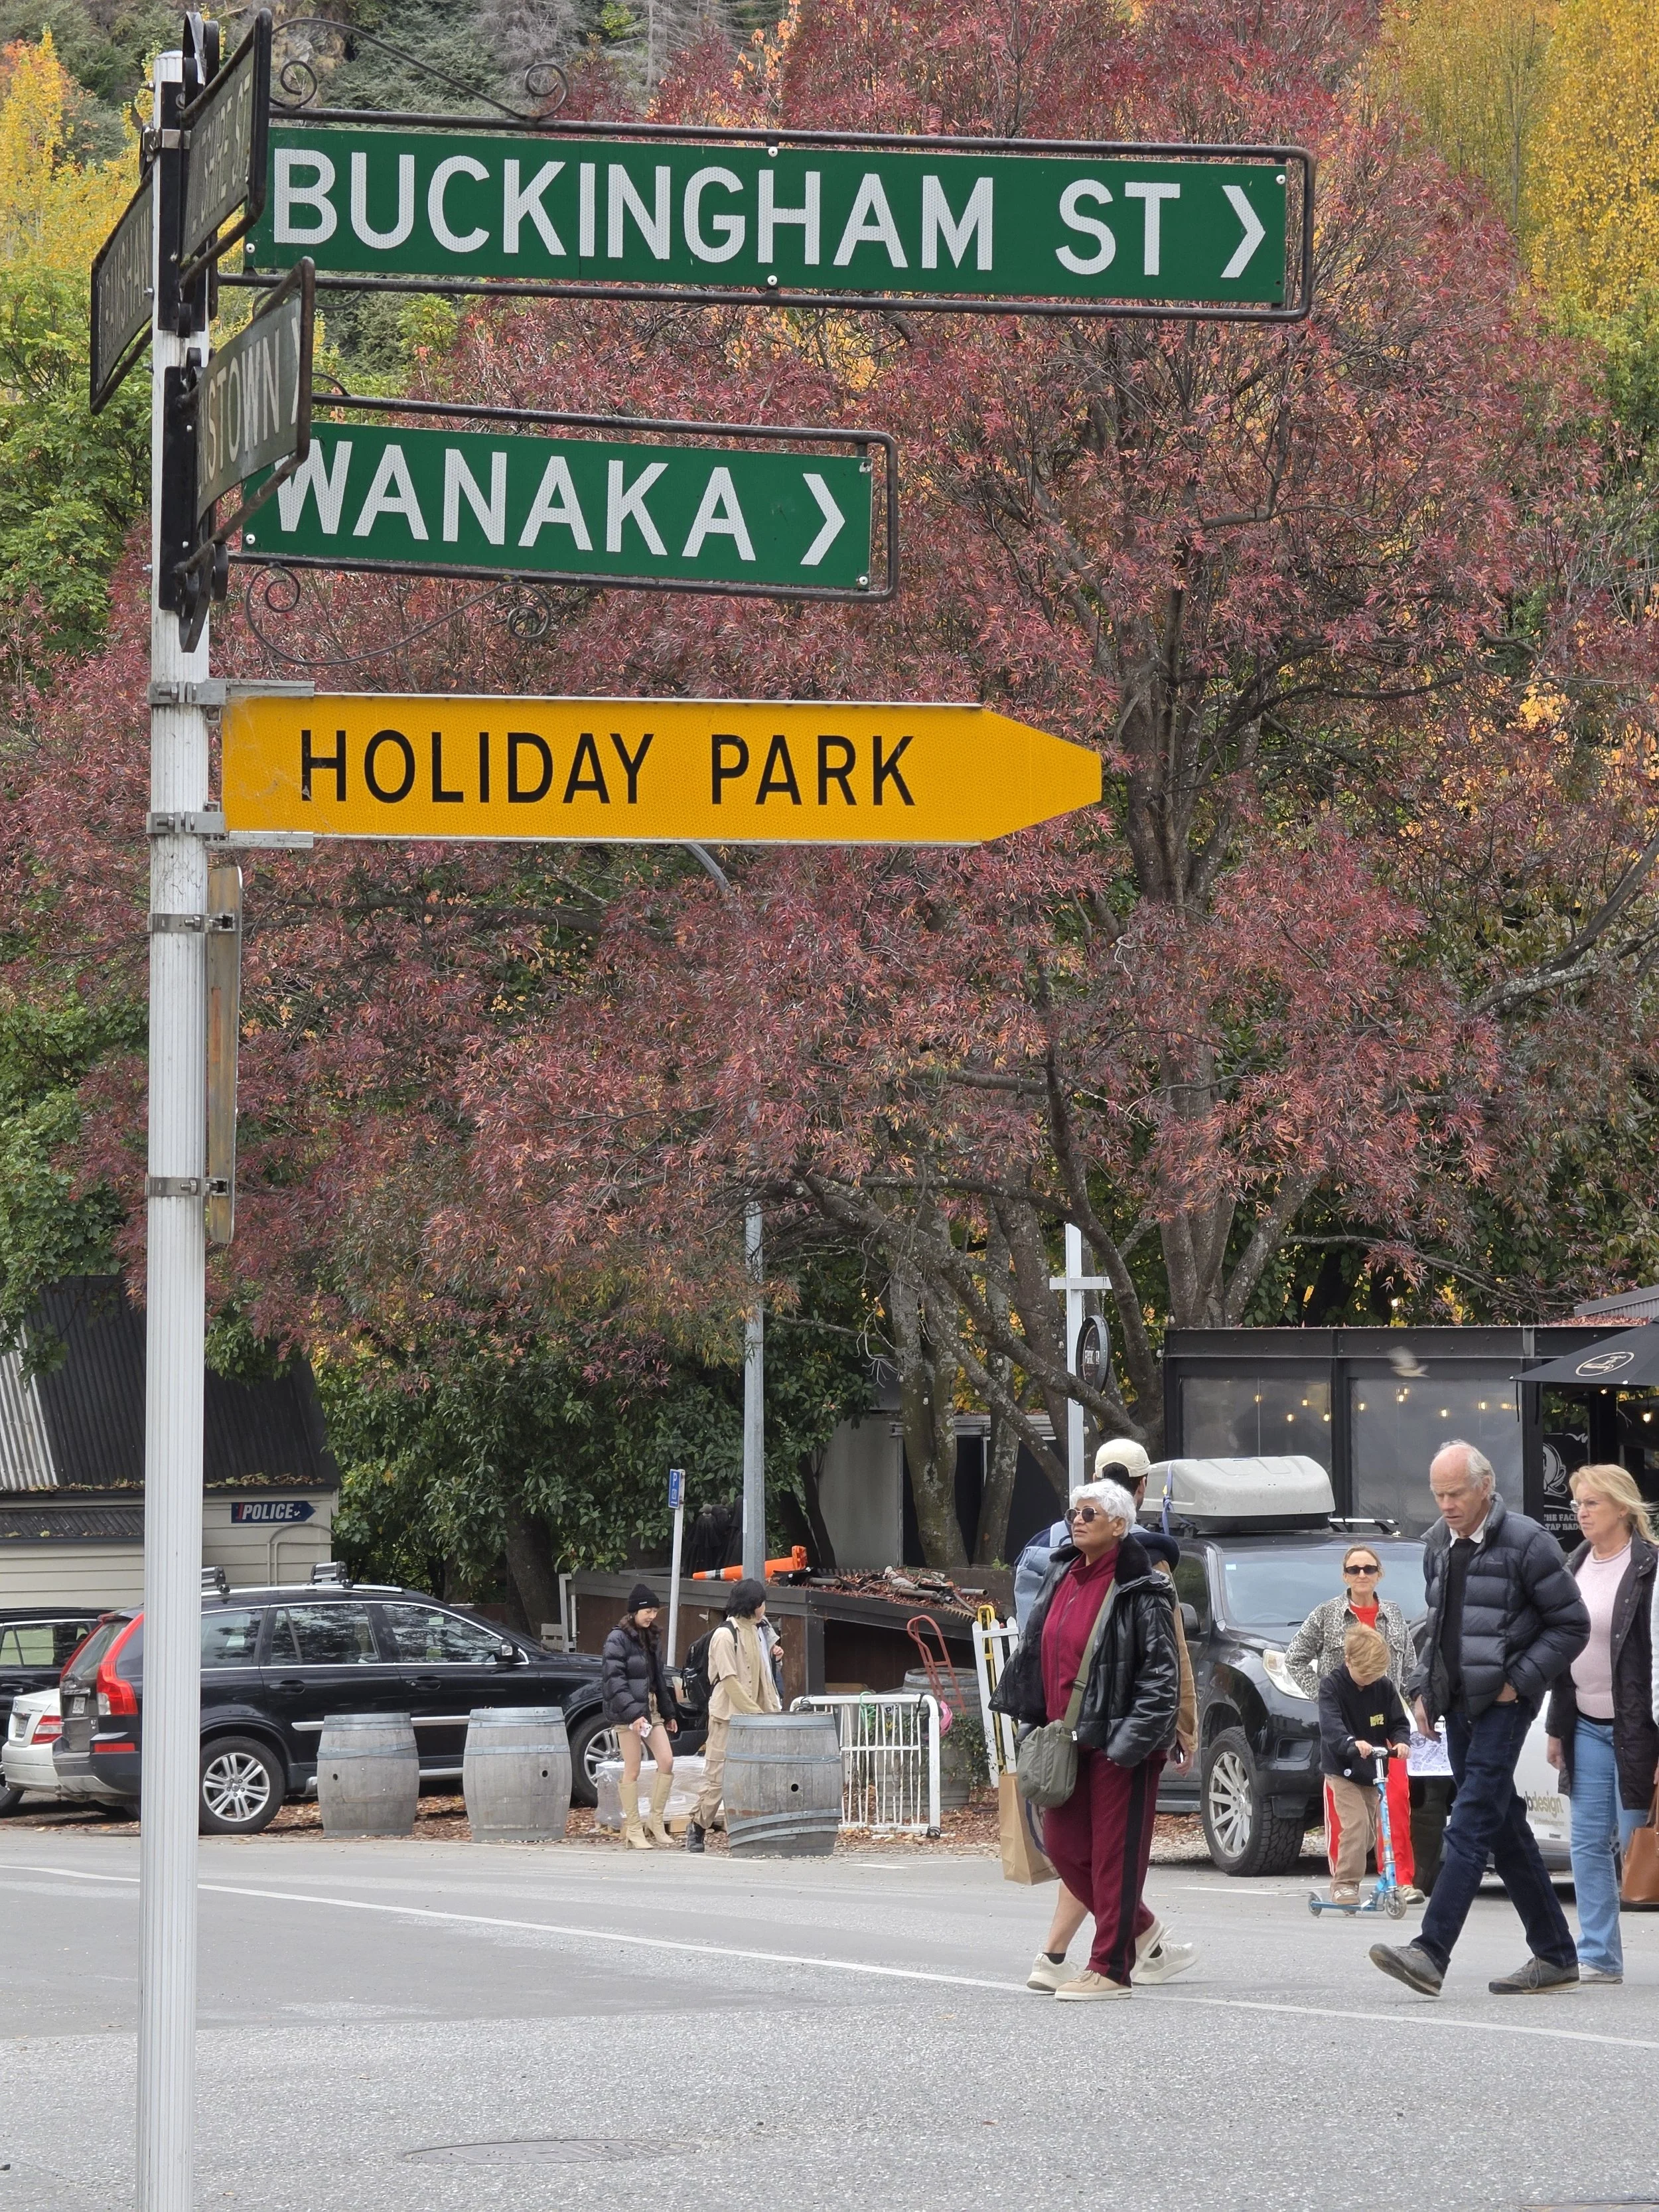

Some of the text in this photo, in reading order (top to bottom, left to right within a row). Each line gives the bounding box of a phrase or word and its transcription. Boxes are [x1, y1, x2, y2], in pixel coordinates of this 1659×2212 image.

[232, 72, 251, 188] ST
[272, 147, 1181, 277] BUCKINGHAM ST
[274, 439, 757, 561] WANAKA
[299, 729, 916, 806] HOLIDAY PARK
[242, 1503, 295, 1520] POLICE
[672, 1472, 678, 1487] P
